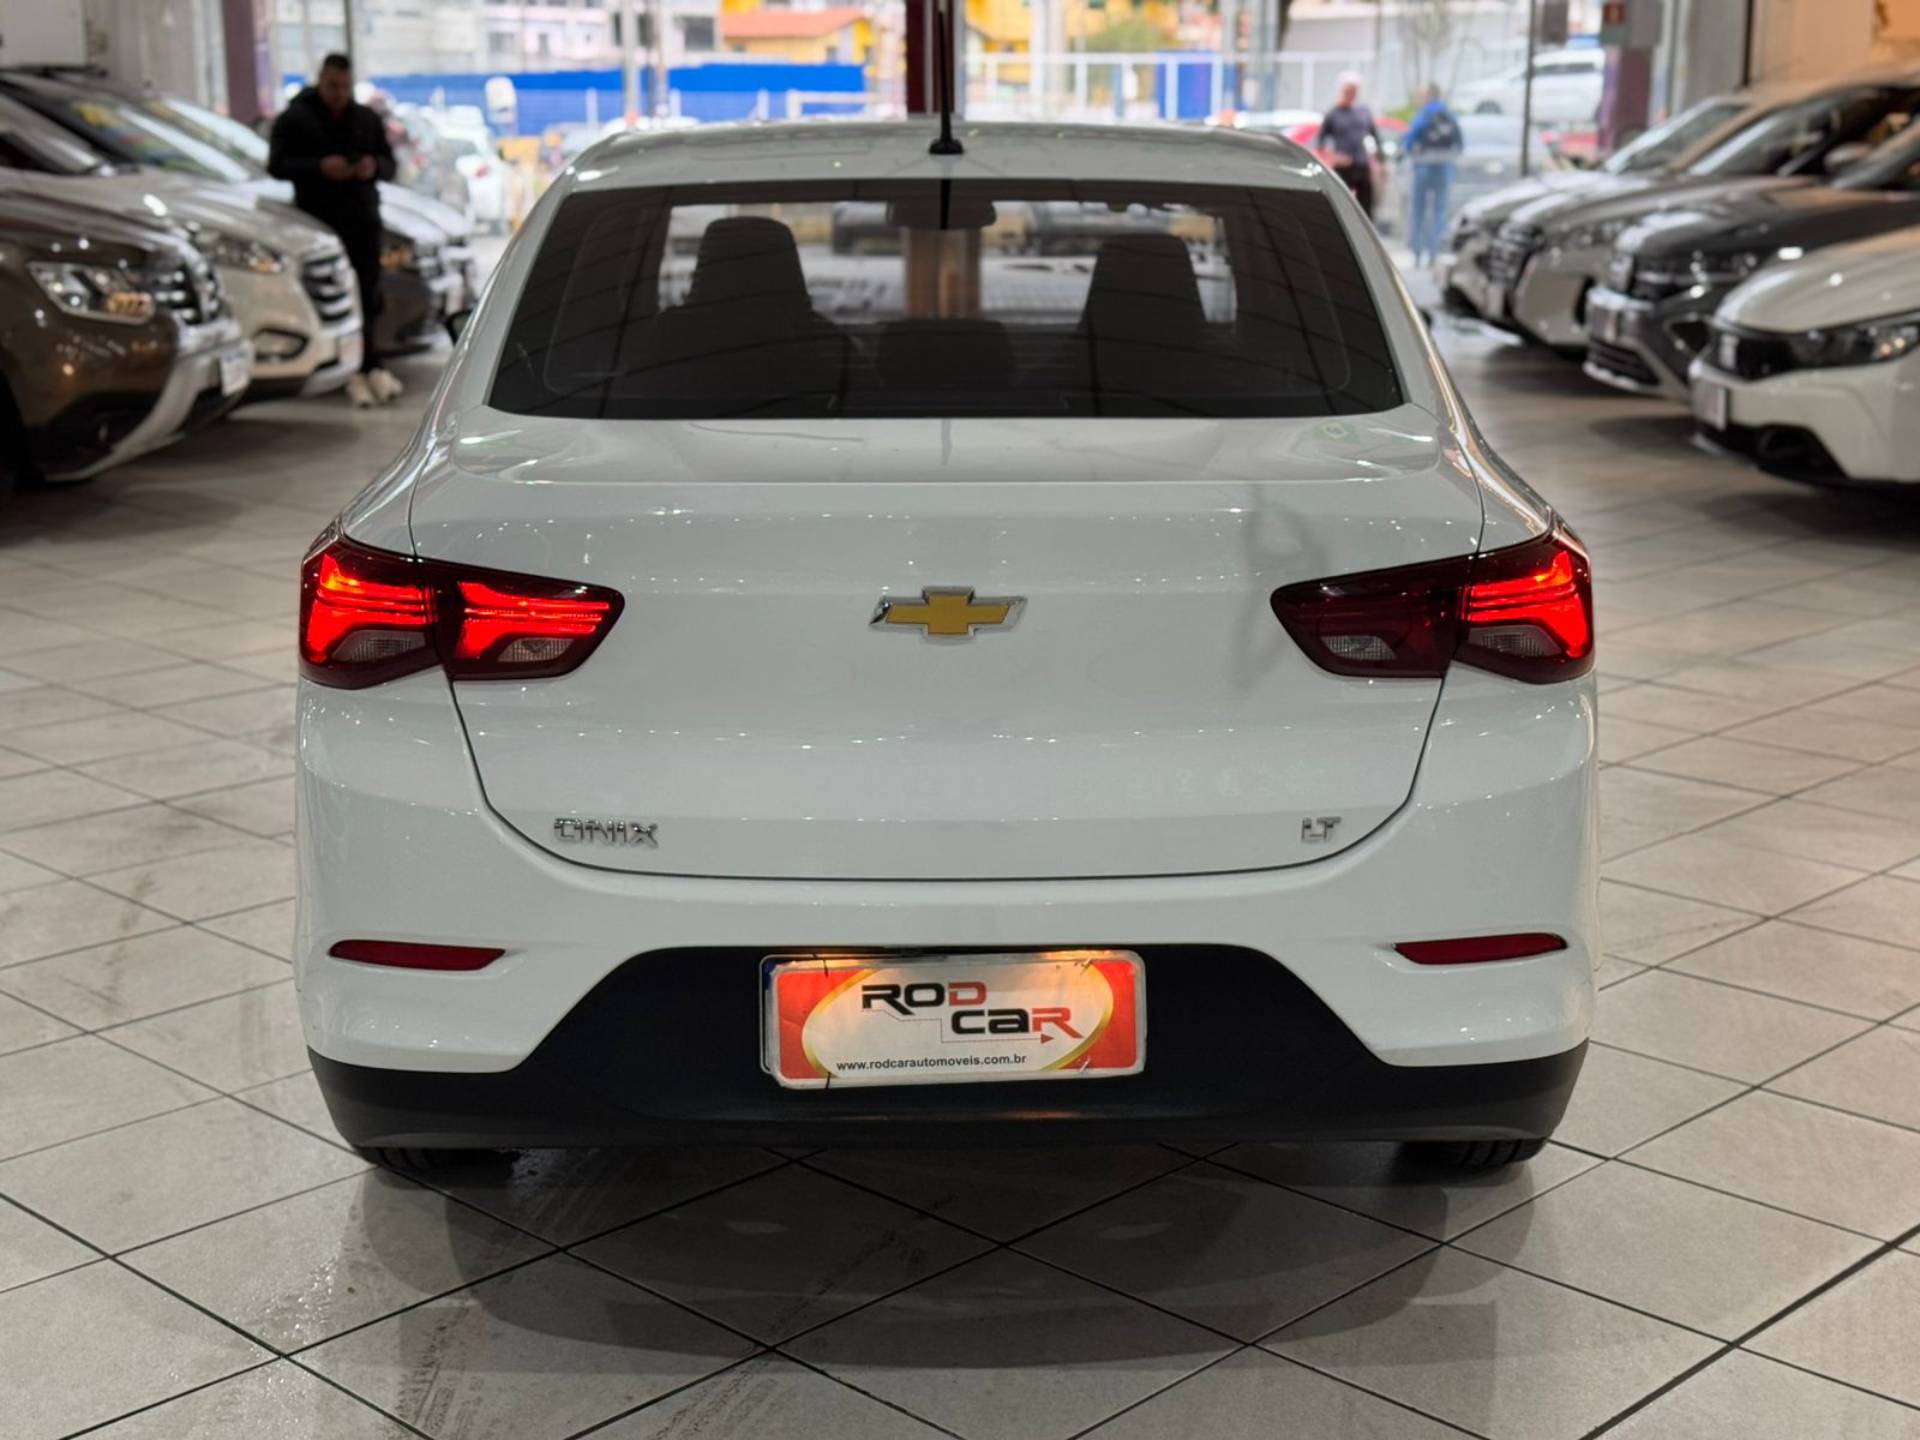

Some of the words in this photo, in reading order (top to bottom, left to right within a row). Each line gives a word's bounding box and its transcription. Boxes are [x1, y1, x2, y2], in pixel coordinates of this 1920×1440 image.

[554, 818, 659, 848] ONIX
[1302, 817, 1341, 843] LT
[861, 981, 987, 1015] ROD
[836, 1054, 1027, 1071] www.rodcarautomoveis.com.br
